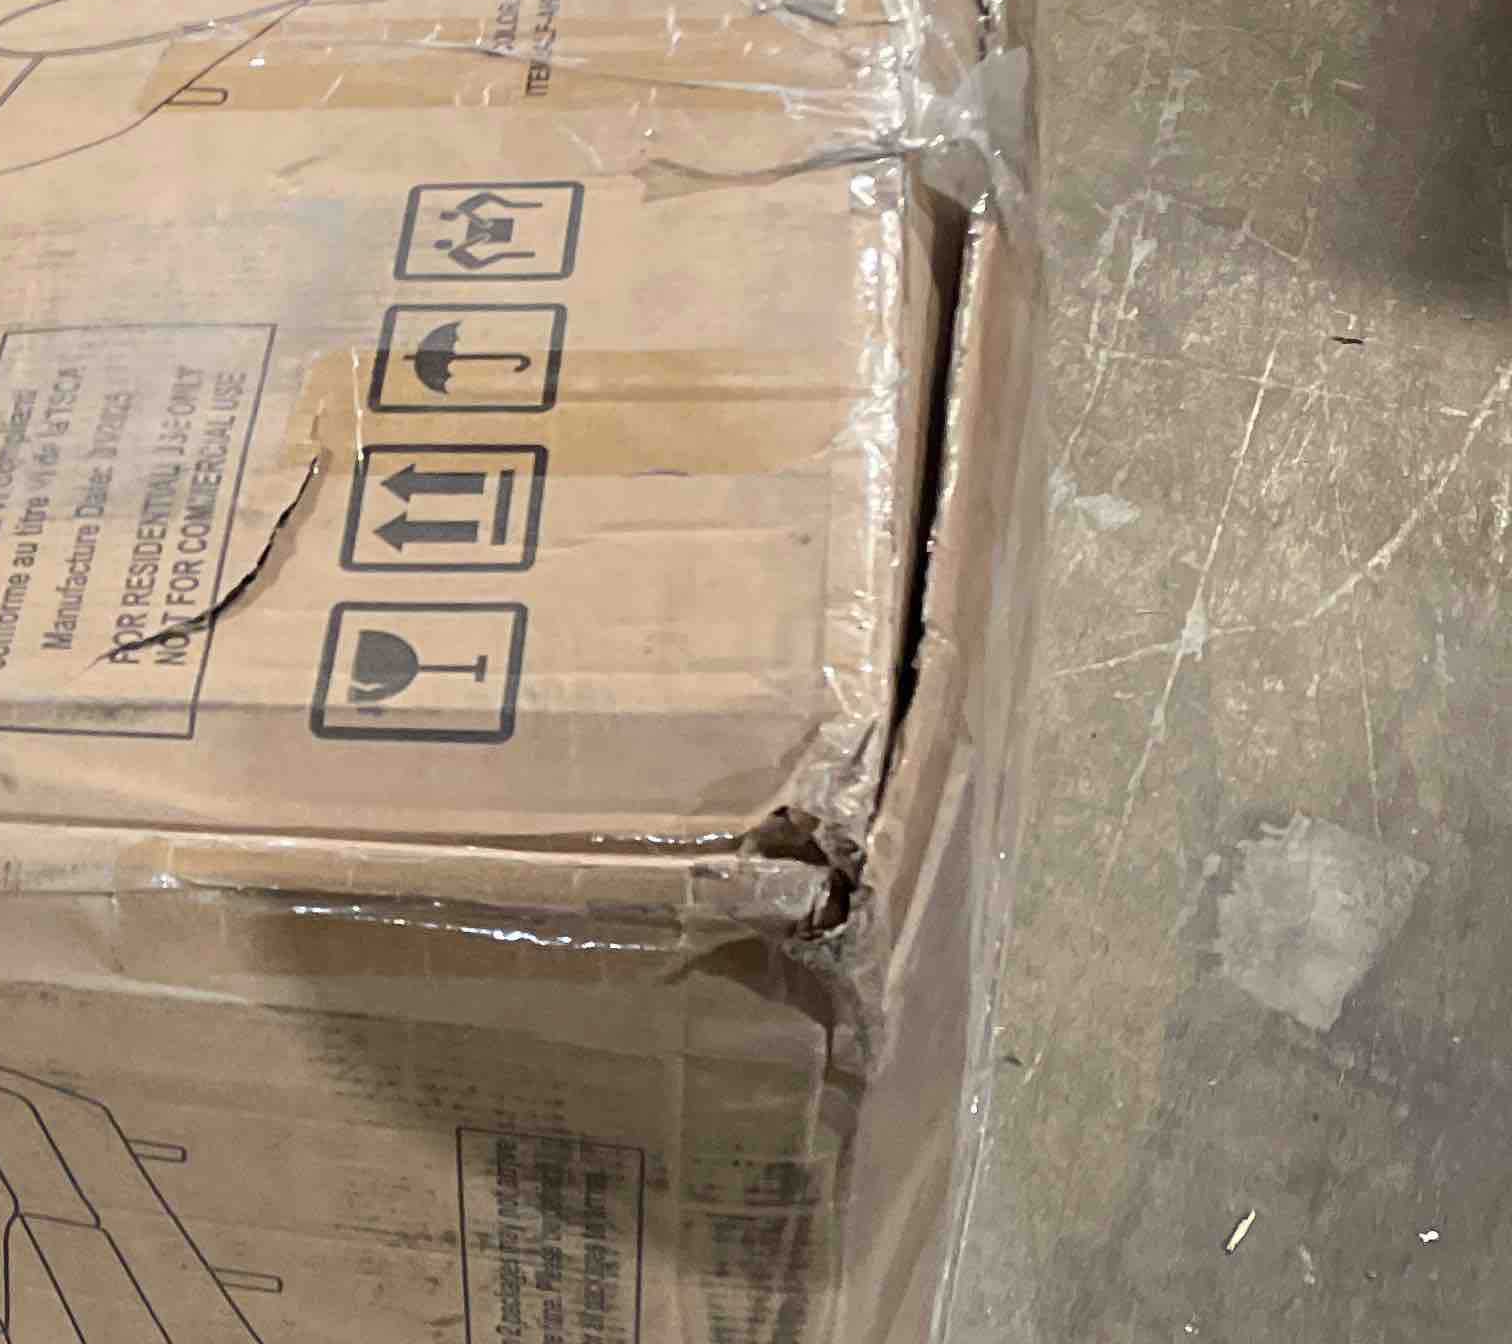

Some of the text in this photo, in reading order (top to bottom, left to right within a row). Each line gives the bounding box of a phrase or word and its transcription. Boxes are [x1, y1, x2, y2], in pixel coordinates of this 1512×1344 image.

[210, 372, 245, 409] USE
[13, 496, 49, 535] titre
[120, 465, 182, 606] RESIDENTIAL
[12, 543, 39, 567] au
[40, 524, 101, 649] Manufacture
[165, 560, 204, 604] FOR
[107, 613, 147, 663] FOR
[155, 613, 194, 665] NOT
